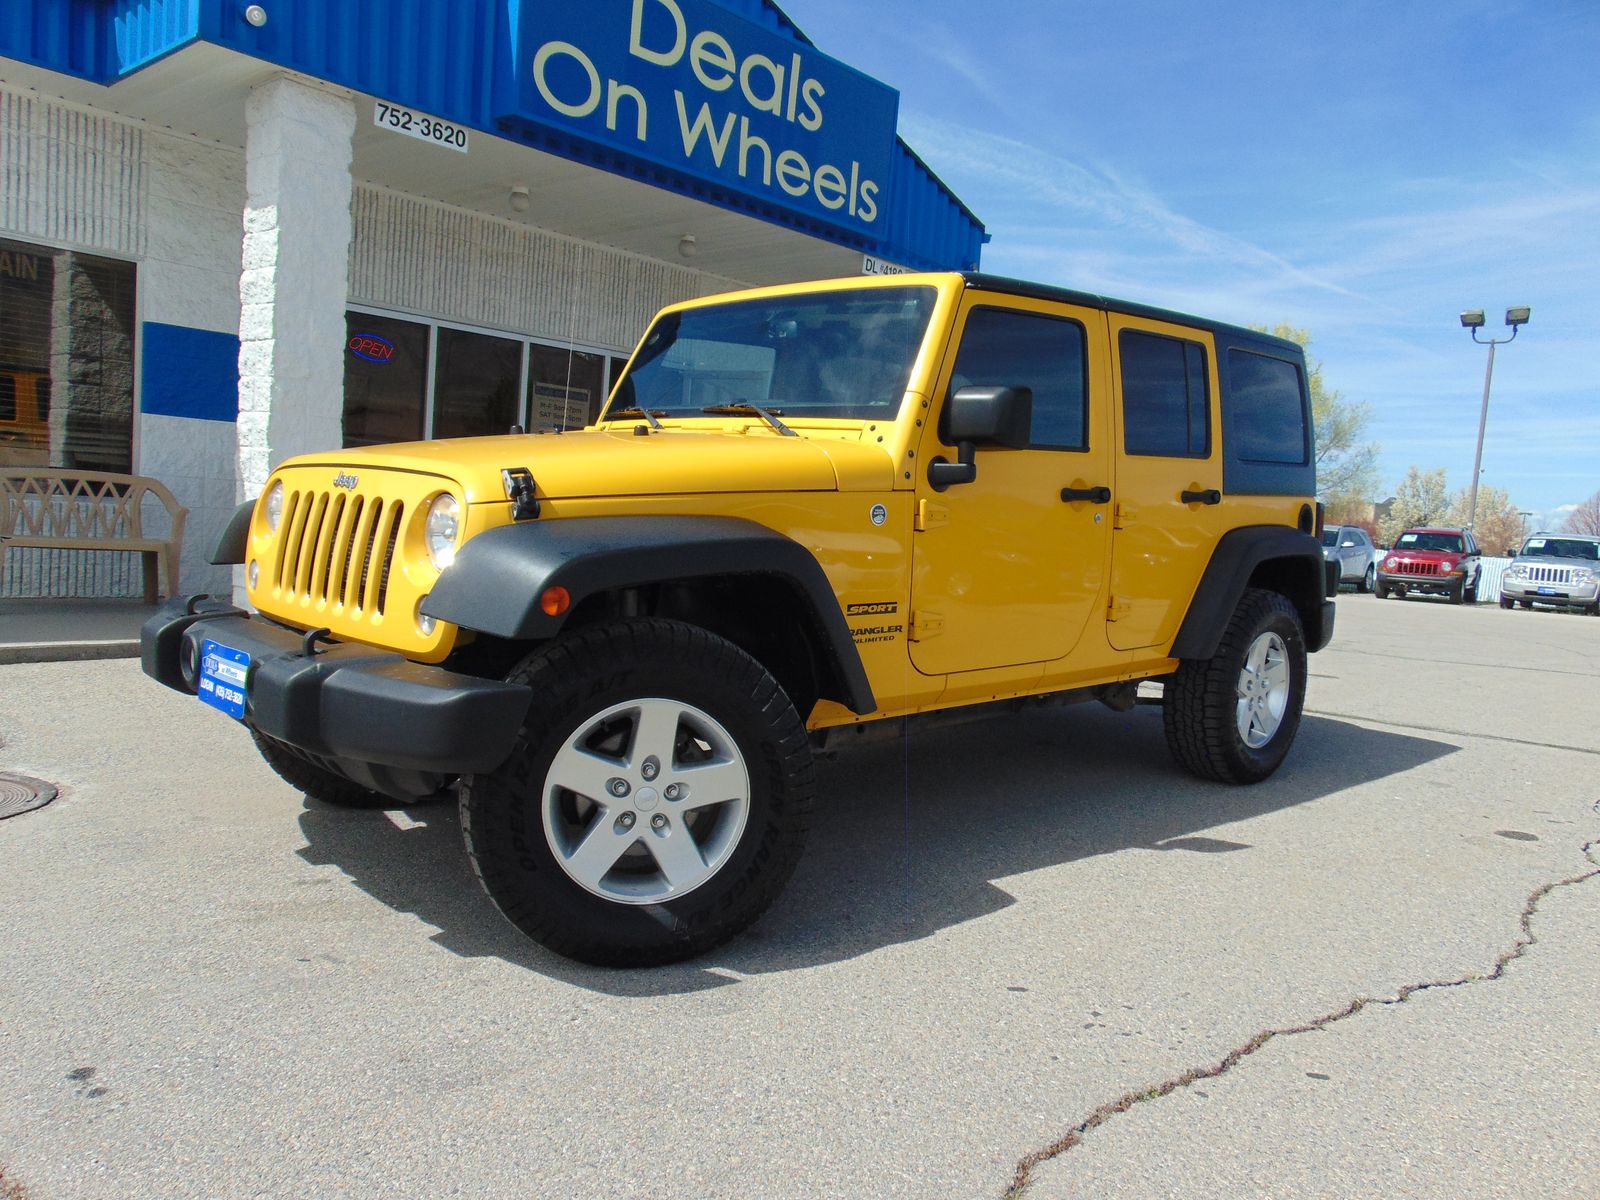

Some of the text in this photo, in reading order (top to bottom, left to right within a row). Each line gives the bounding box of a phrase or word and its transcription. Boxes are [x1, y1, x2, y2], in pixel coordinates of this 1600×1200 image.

[629, 0, 825, 131] Deals
[377, 102, 467, 148] 752-3620
[533, 41, 879, 222] On Wheels
[865, 258, 878, 274] DL
[349, 336, 394, 359] OPEN
[333, 470, 359, 492] Jeep
[849, 603, 898, 614] SPORT
[850, 625, 902, 635] RANGLER
